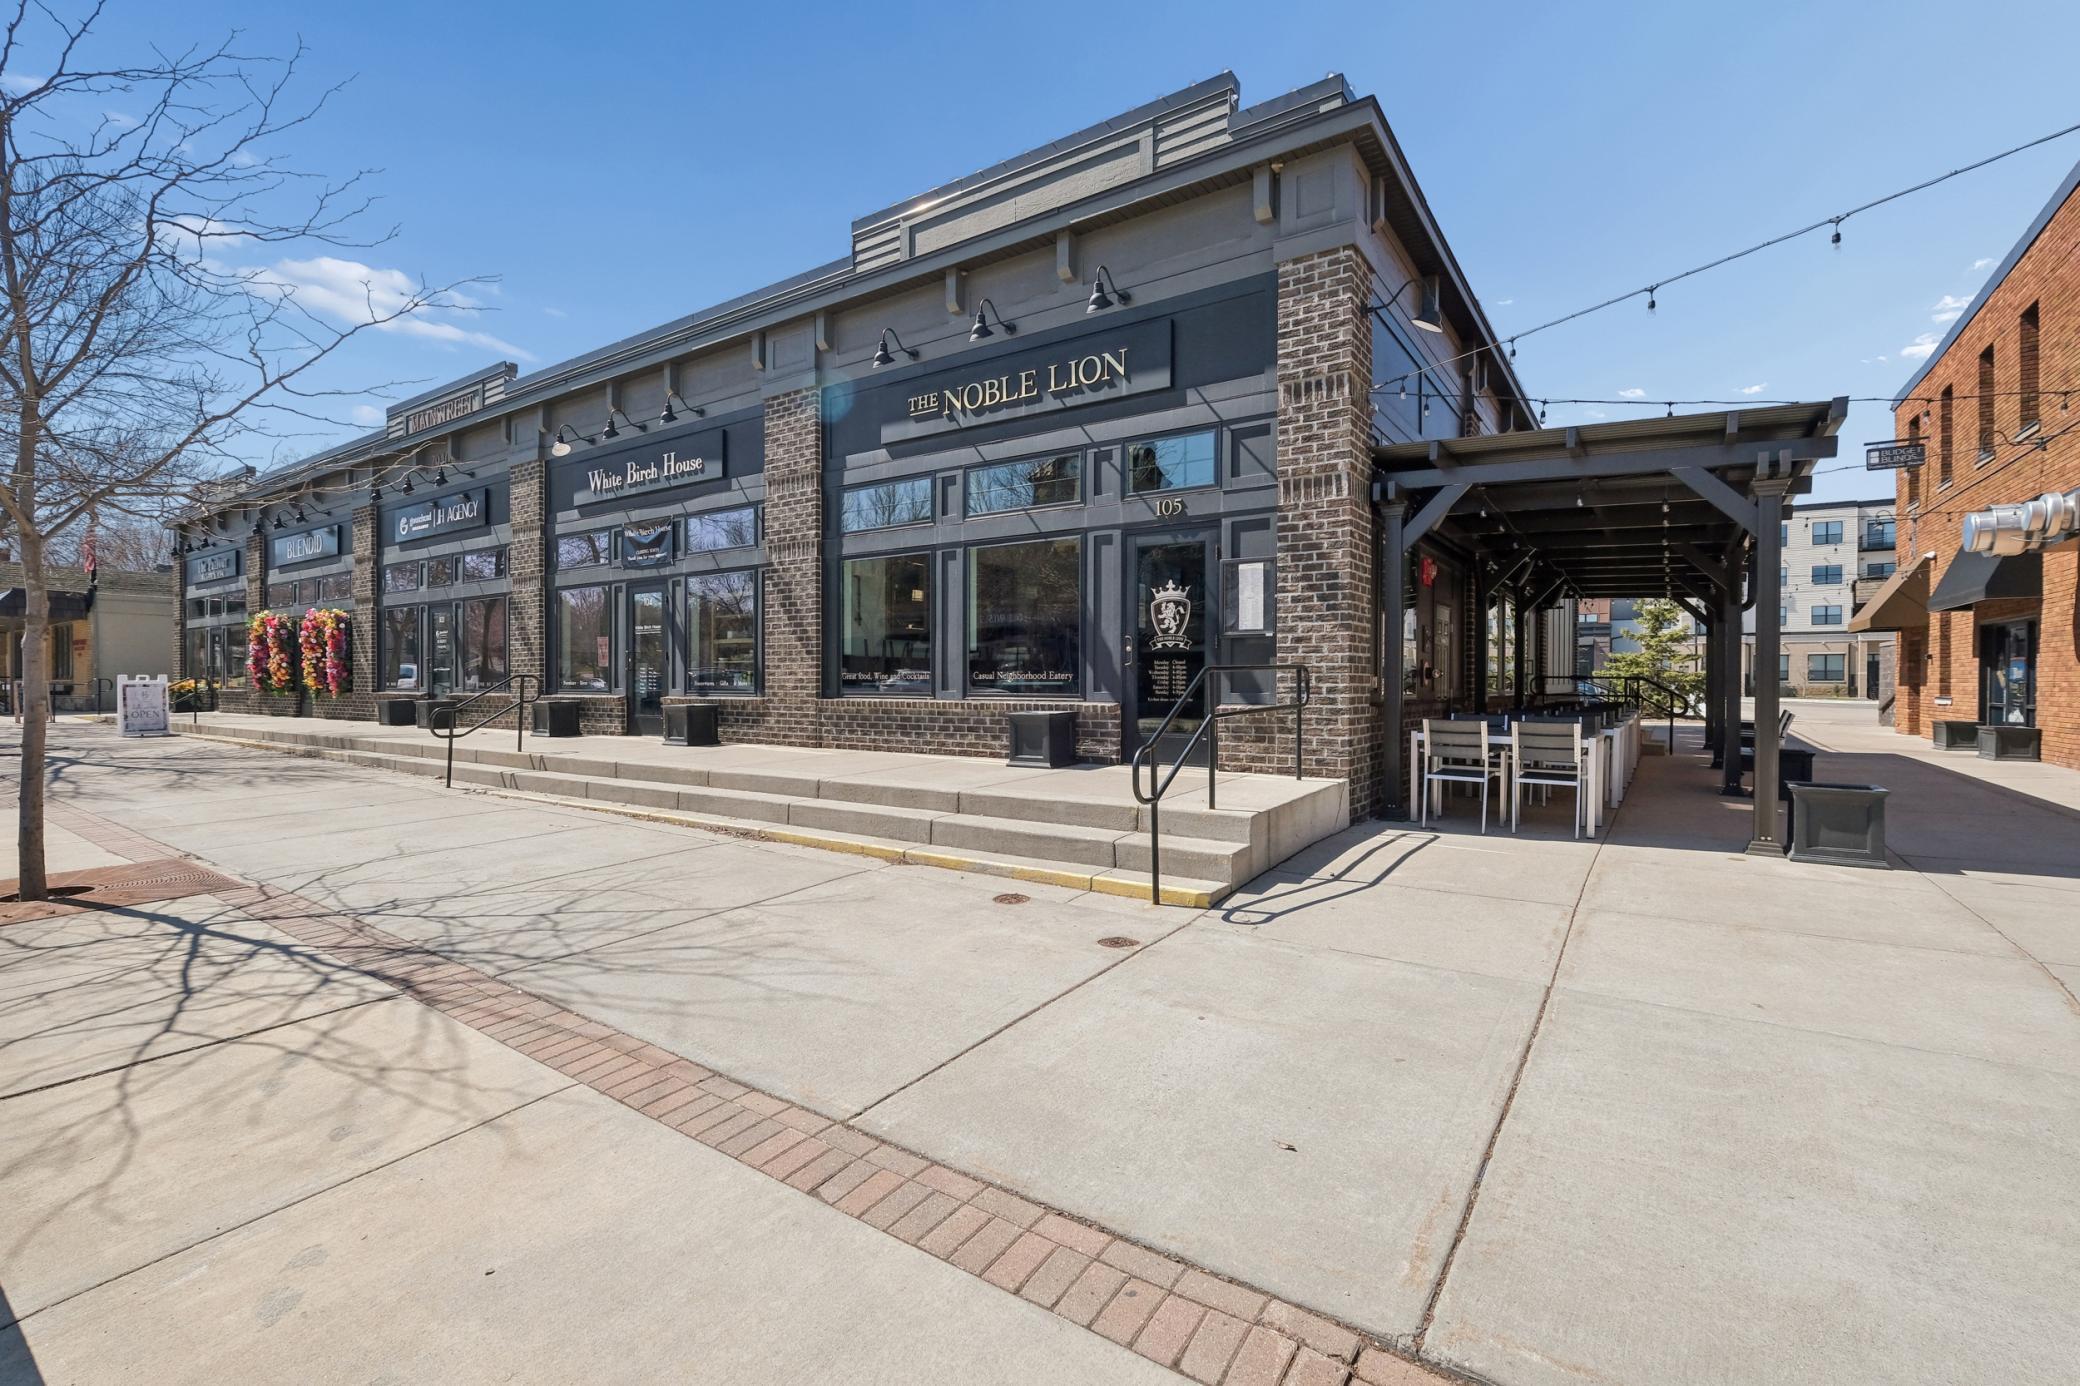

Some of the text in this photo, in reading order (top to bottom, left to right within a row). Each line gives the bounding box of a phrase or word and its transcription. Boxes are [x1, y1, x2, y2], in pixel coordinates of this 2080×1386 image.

[908, 348, 1128, 416] THE NOBLE LION
[1881, 447, 1922, 457] BUDGET
[1881, 454, 1918, 463] BLINDS
[587, 452, 703, 492] White Birch House
[446, 501, 479, 523] AGENCY
[1155, 498, 1182, 517] 105
[286, 535, 323, 559] BLENDID
[973, 671, 1073, 682] Casual Neighborhood Eatery
[131, 711, 160, 719] OPEN
